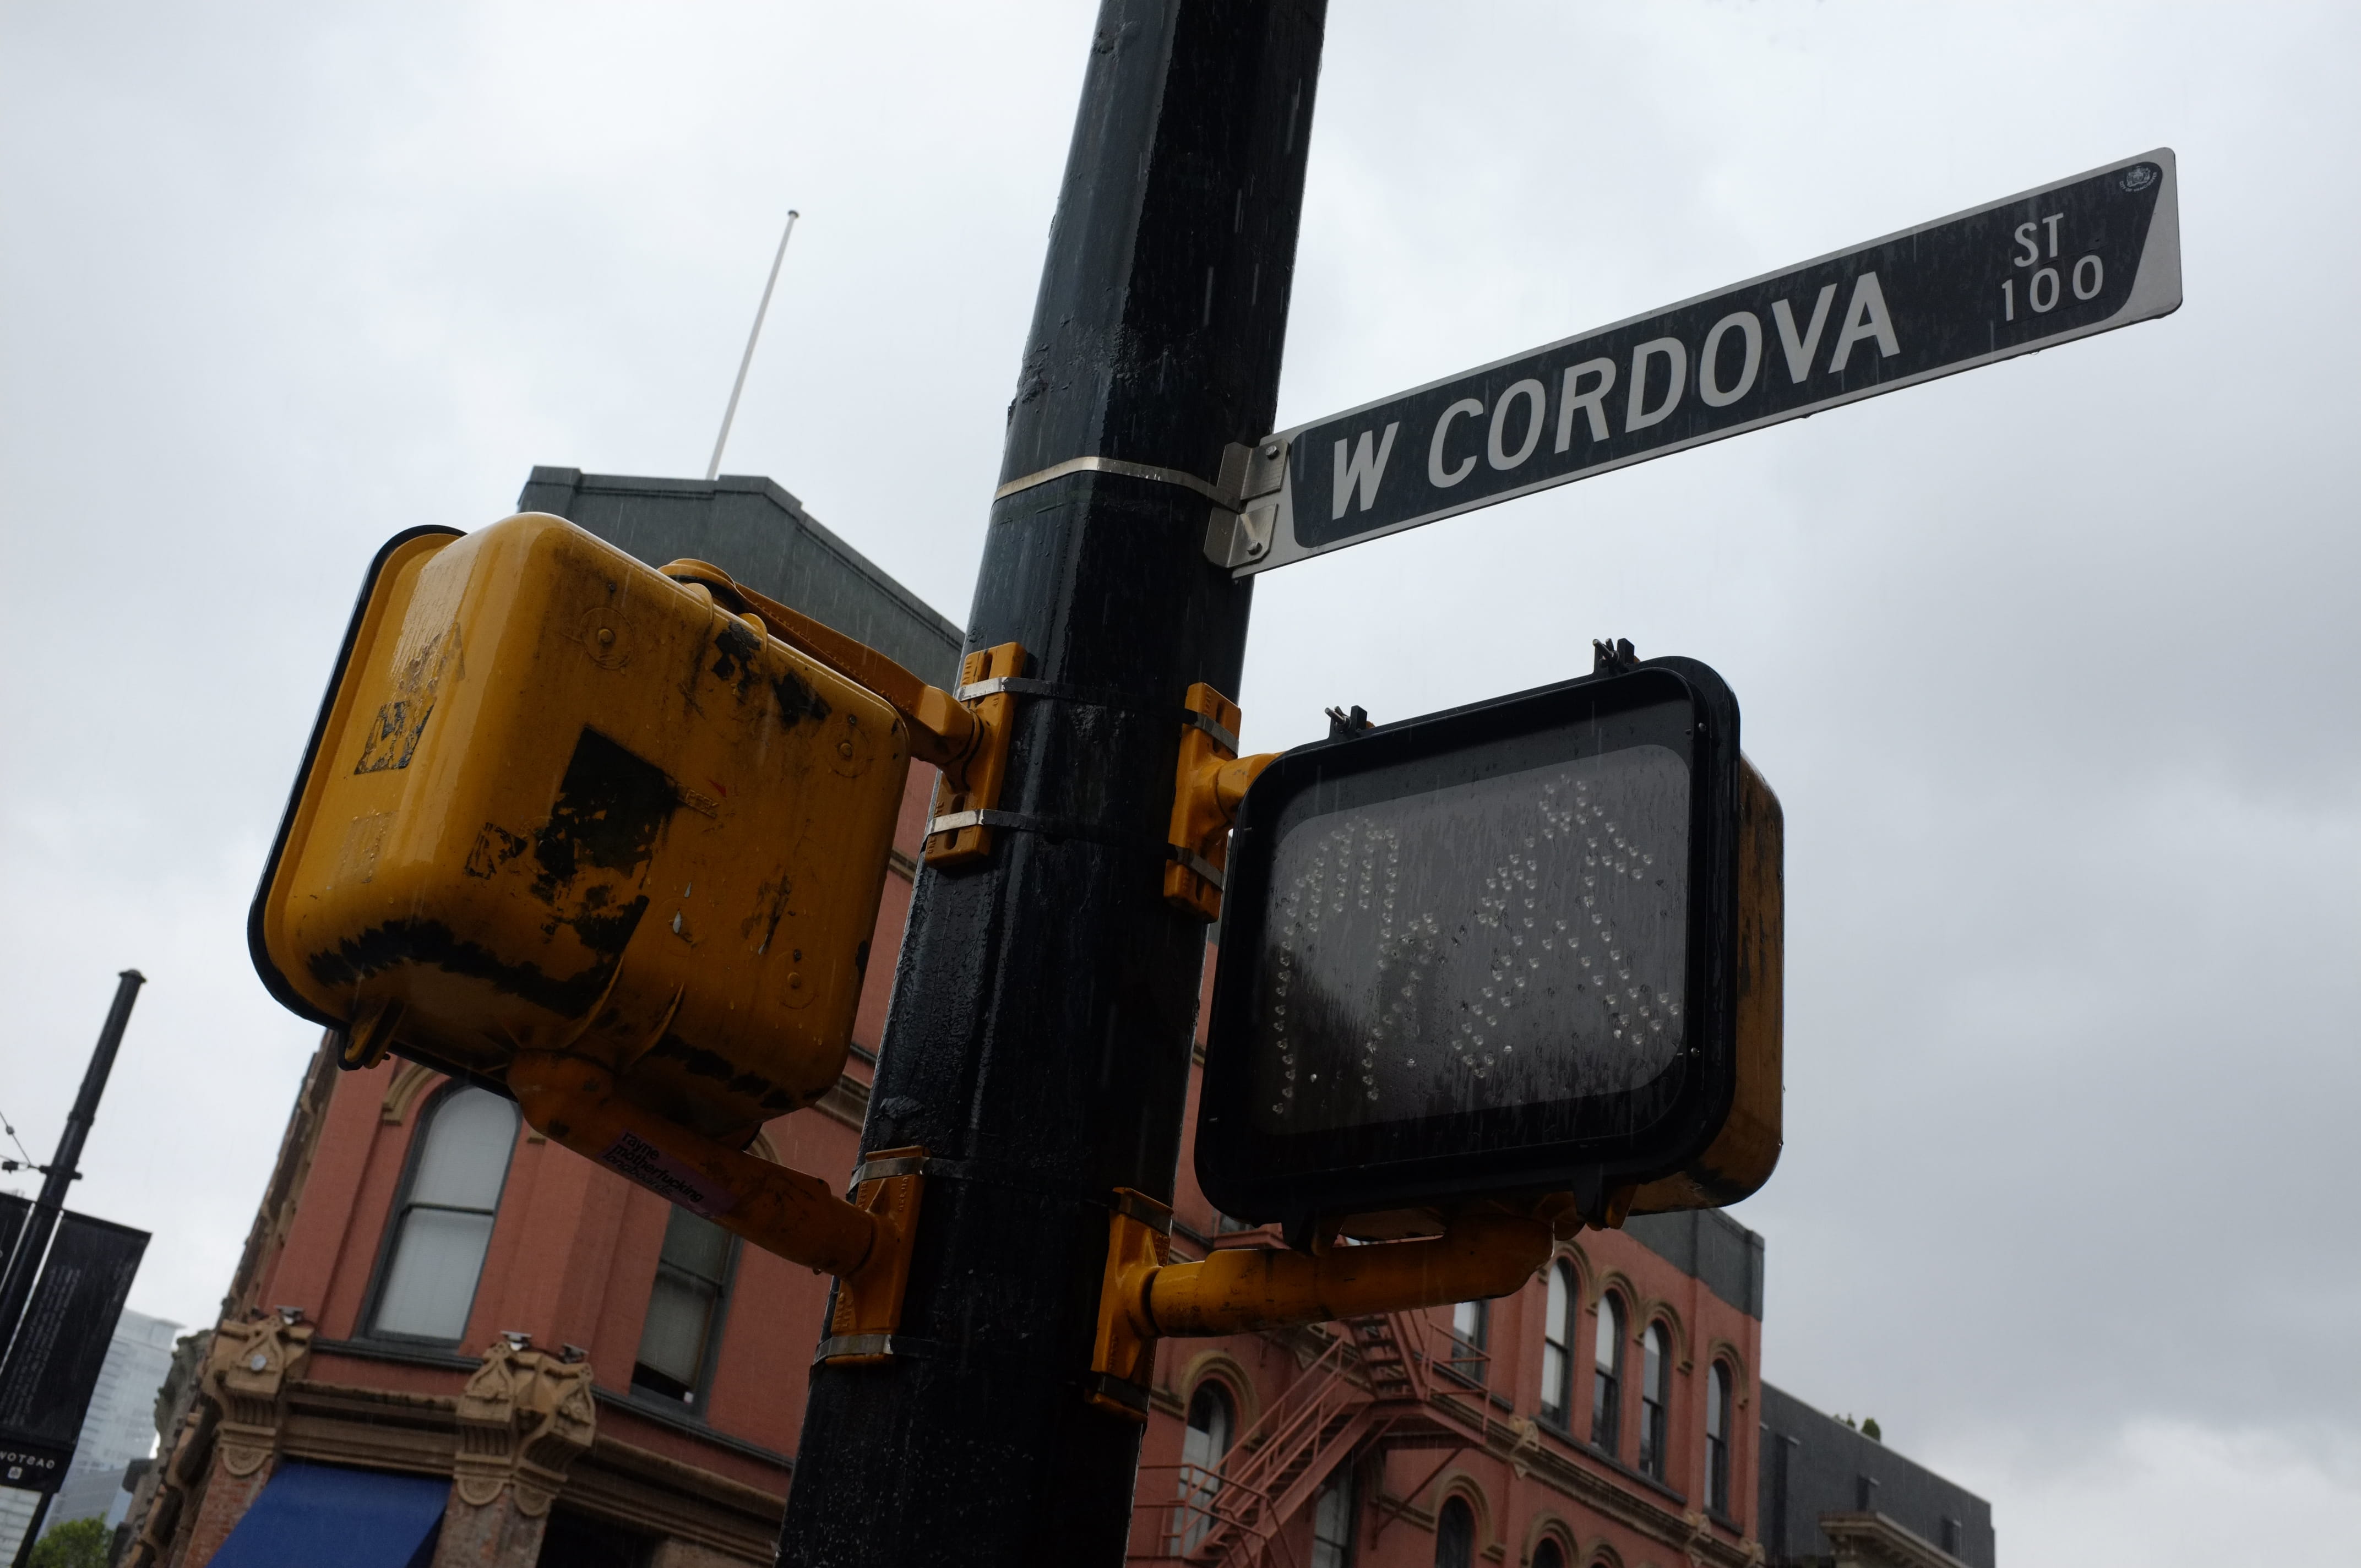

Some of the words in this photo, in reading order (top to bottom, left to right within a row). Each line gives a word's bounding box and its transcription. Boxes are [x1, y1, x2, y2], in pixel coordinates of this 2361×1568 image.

[2014, 213, 2064, 268] ST
[2001, 254, 2104, 322] 100
[1332, 421, 1400, 520] W
[1427, 270, 1901, 489] CORDOVA
[613, 1145, 704, 1202] motherfucking
[623, 1133, 659, 1160] rayne
